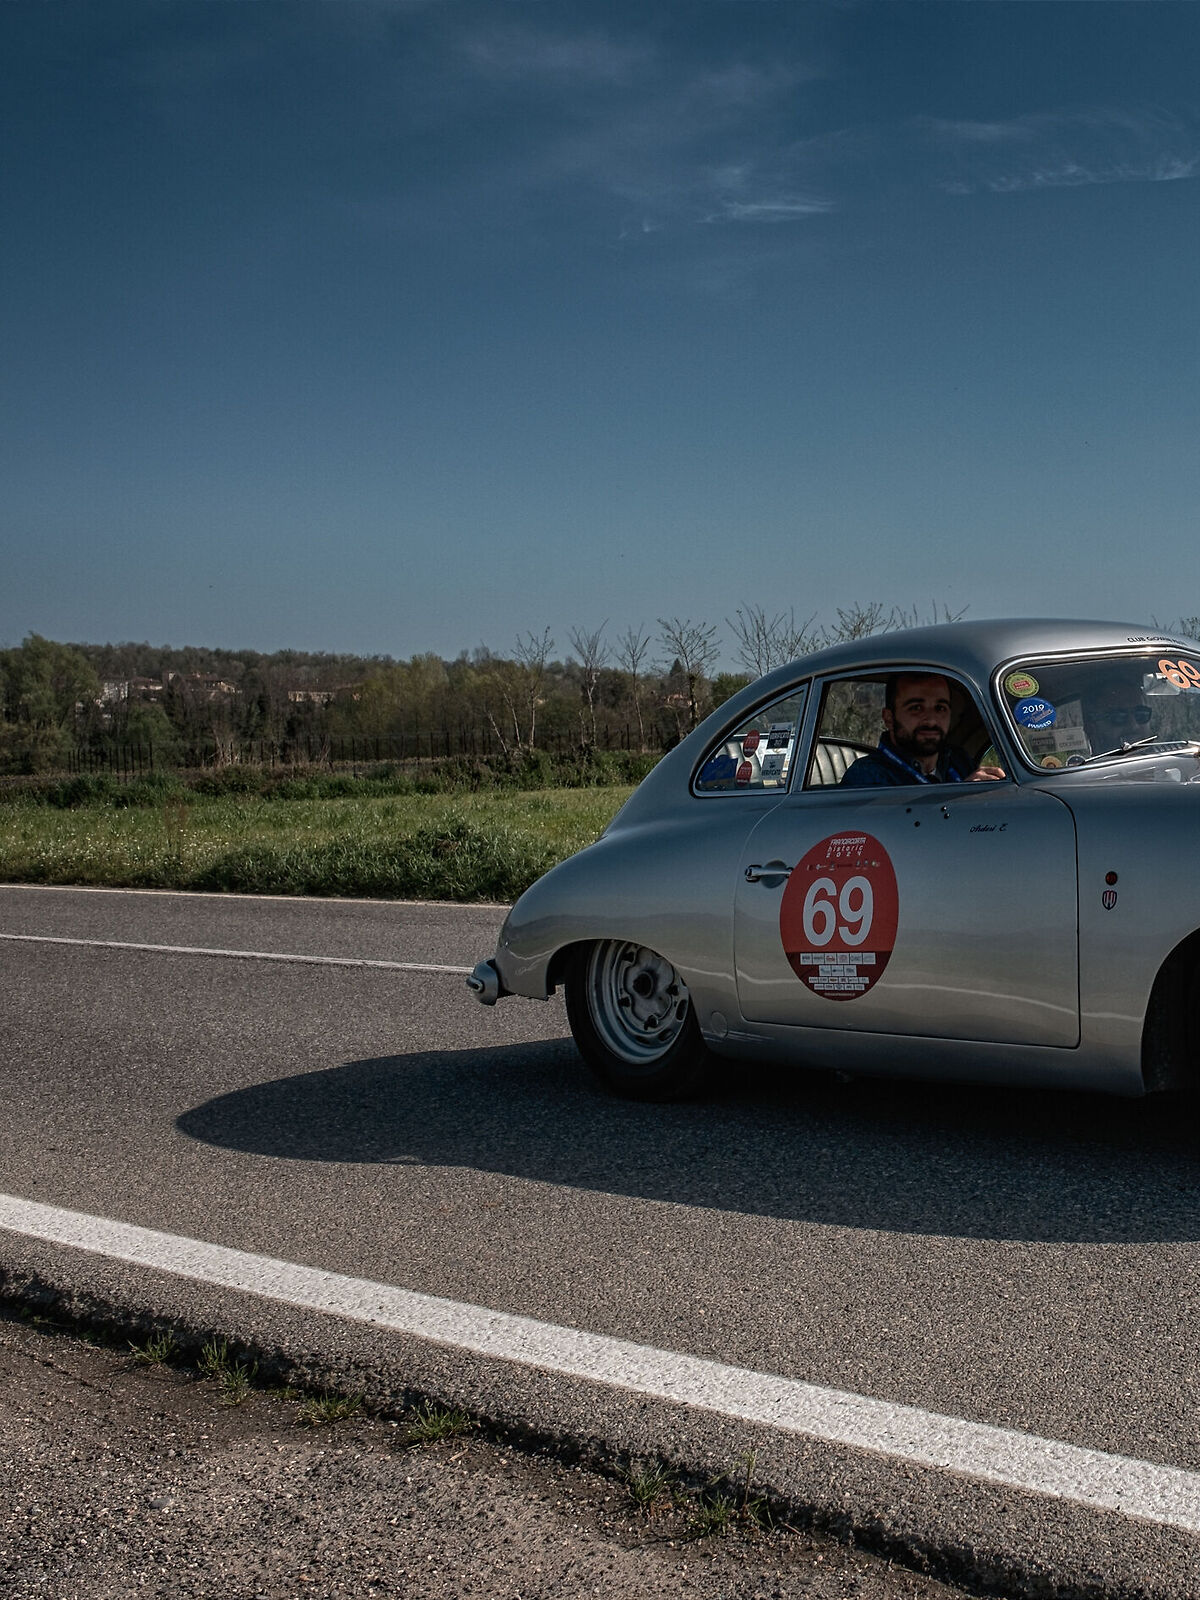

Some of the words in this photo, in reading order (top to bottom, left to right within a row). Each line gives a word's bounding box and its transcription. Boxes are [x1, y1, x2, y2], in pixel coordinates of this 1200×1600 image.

[1022, 703, 1045, 714] 2019
[1027, 719, 1052, 729] PASSED
[828, 845, 864, 853] historic
[802, 875, 874, 947] 69
